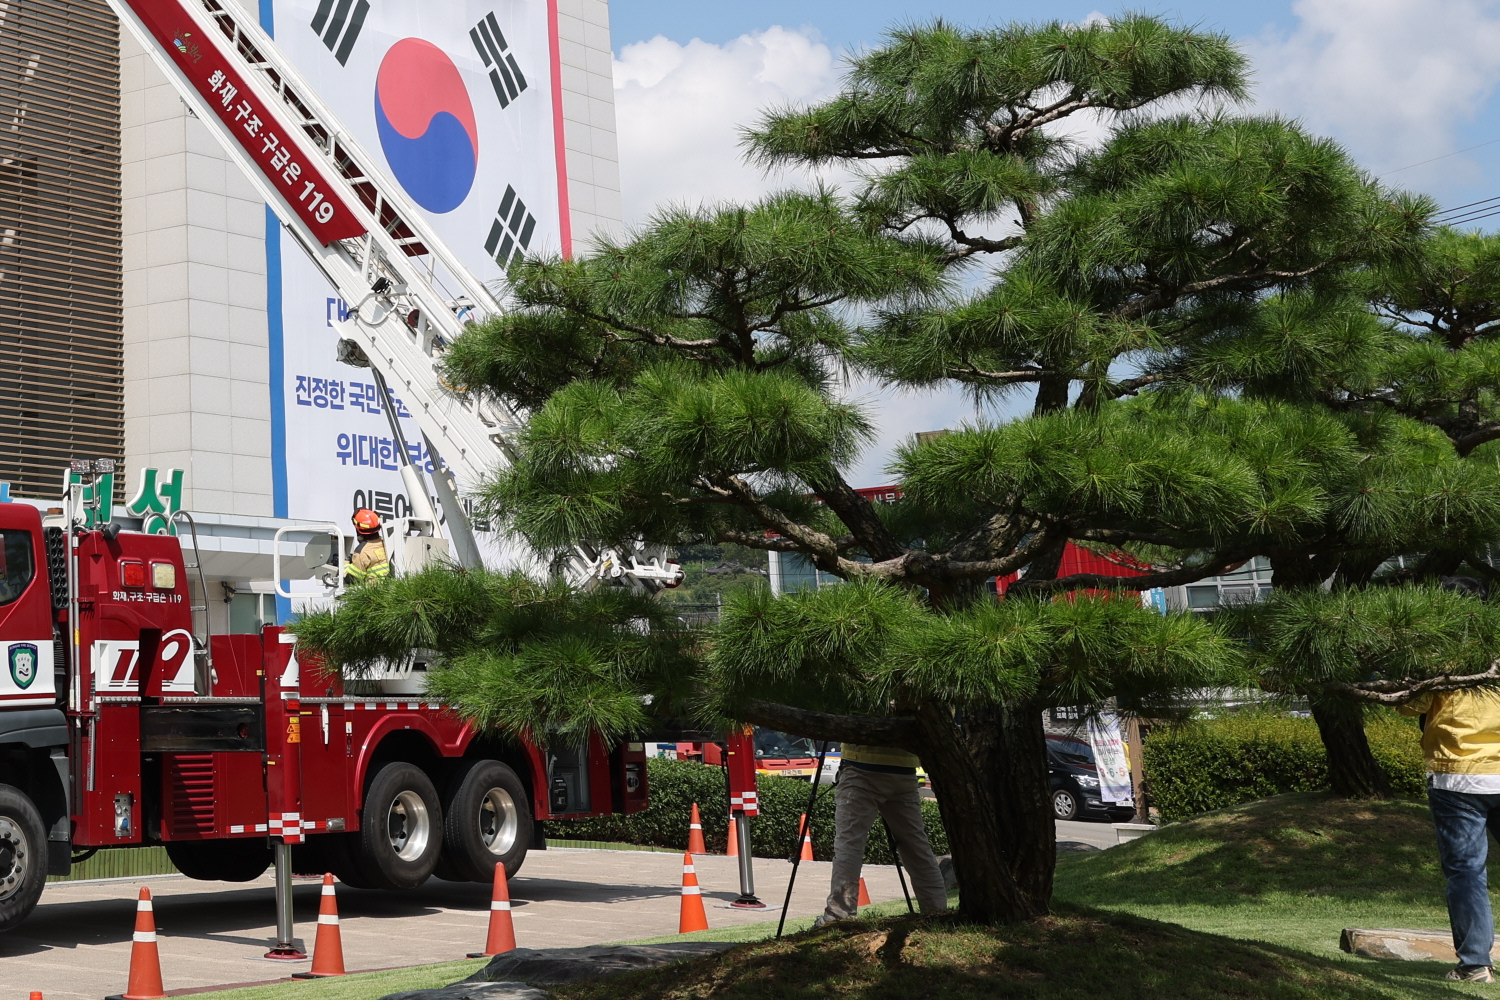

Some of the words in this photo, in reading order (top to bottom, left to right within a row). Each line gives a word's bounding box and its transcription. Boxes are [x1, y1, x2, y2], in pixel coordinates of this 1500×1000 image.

[298, 180, 334, 224] 119
[295, 375, 345, 410] 진정한
[336, 432, 400, 472] 위대한
[168, 594, 182, 604] 119
